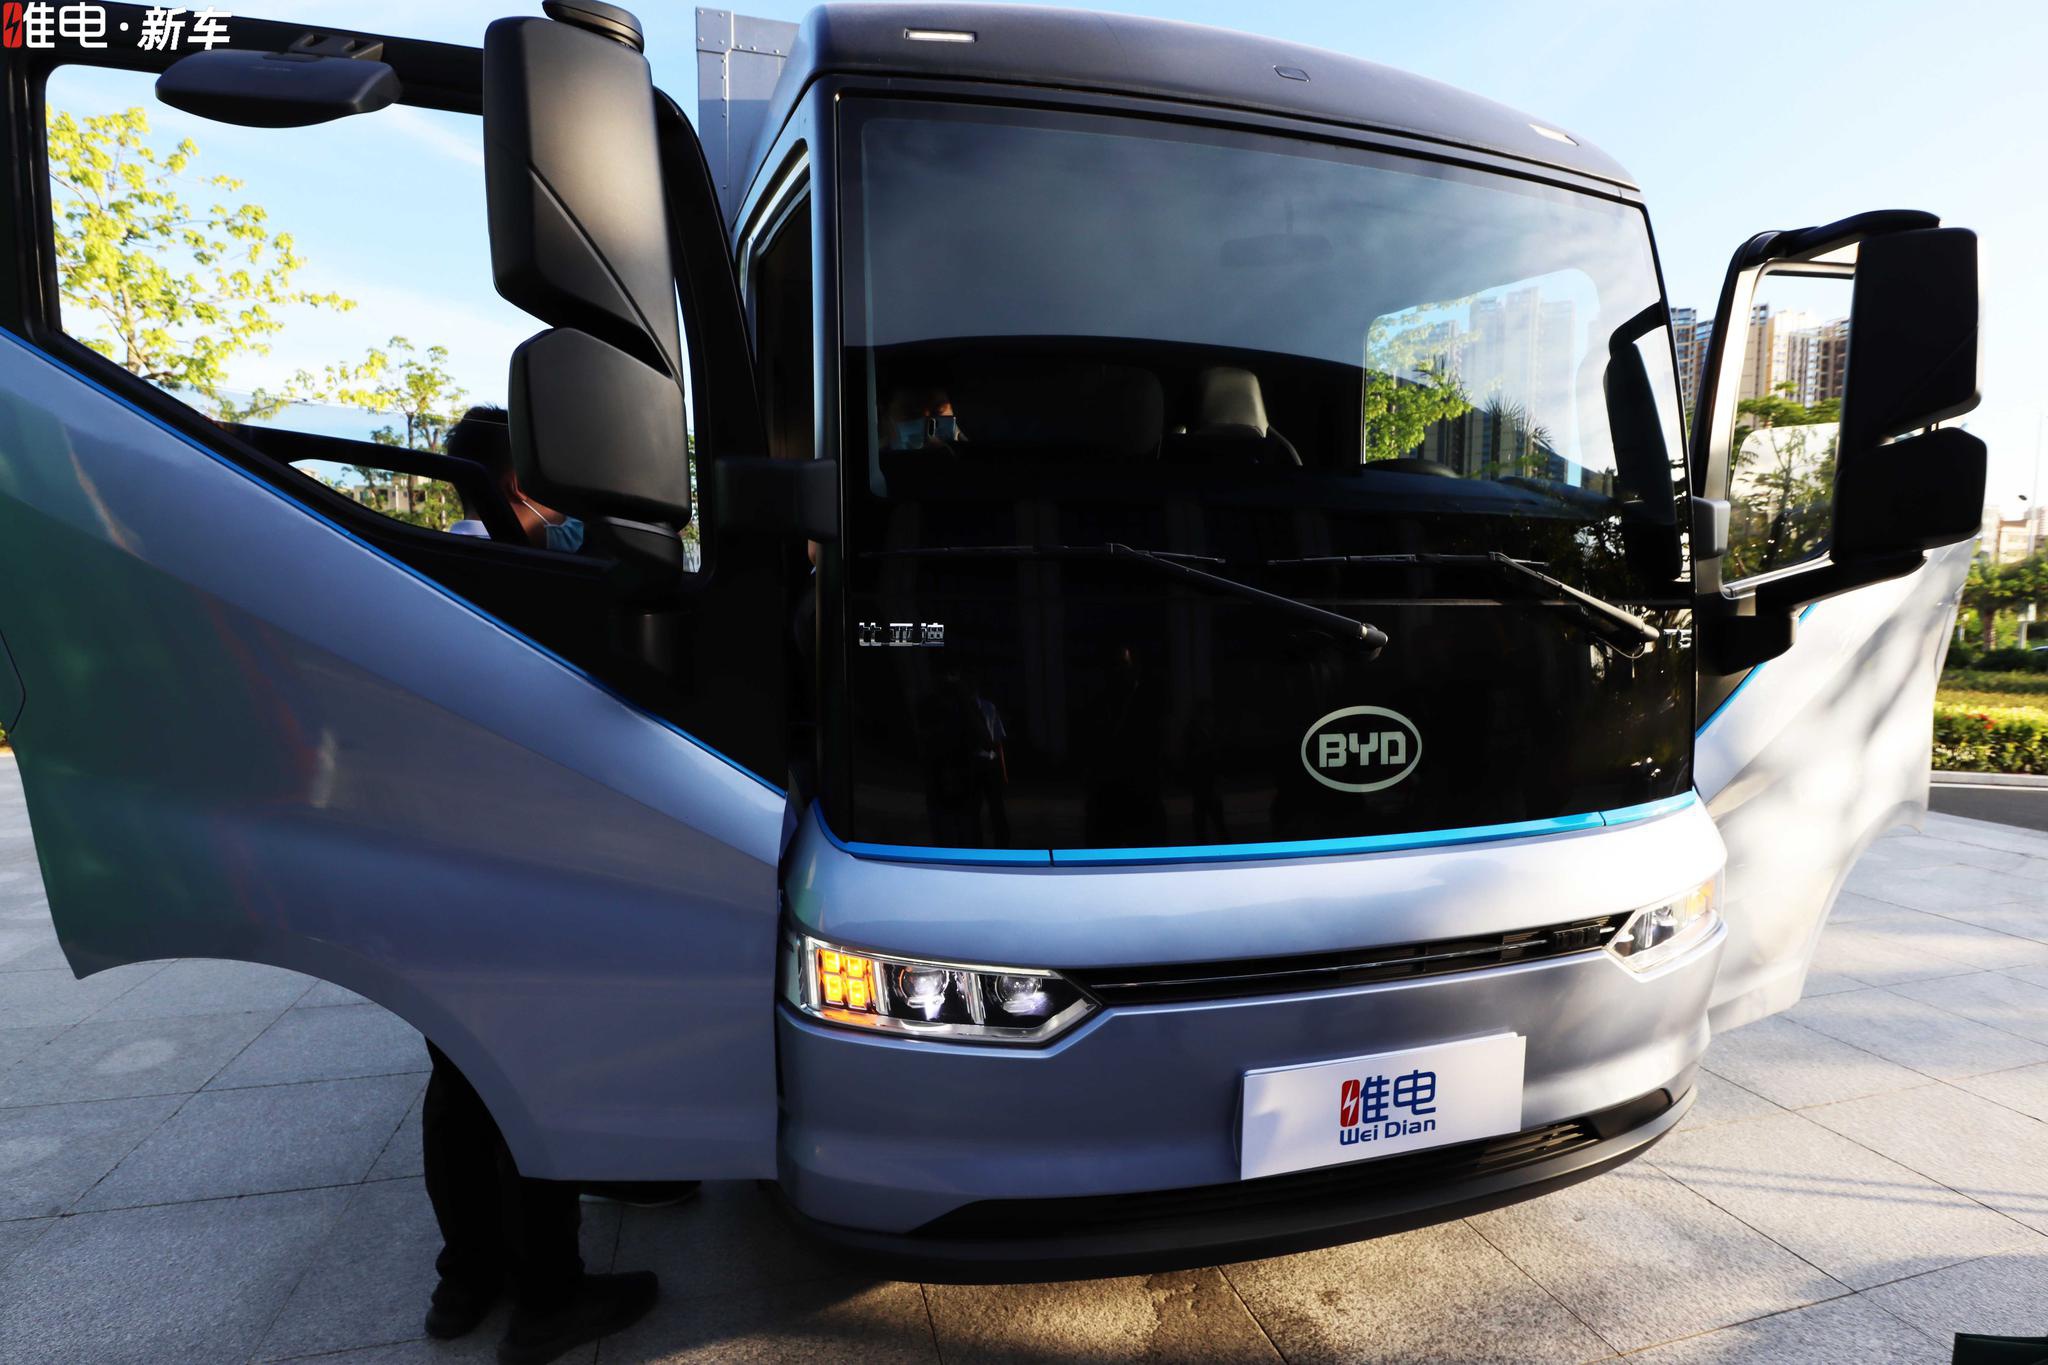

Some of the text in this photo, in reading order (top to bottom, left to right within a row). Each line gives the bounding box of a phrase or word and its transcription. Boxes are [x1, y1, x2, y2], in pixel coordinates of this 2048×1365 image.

[859, 622, 944, 647] 比亚迪
[1663, 628, 1693, 649] T5
[1319, 731, 1406, 768] BYD
[1340, 1119, 1436, 1146] Wei Dian
